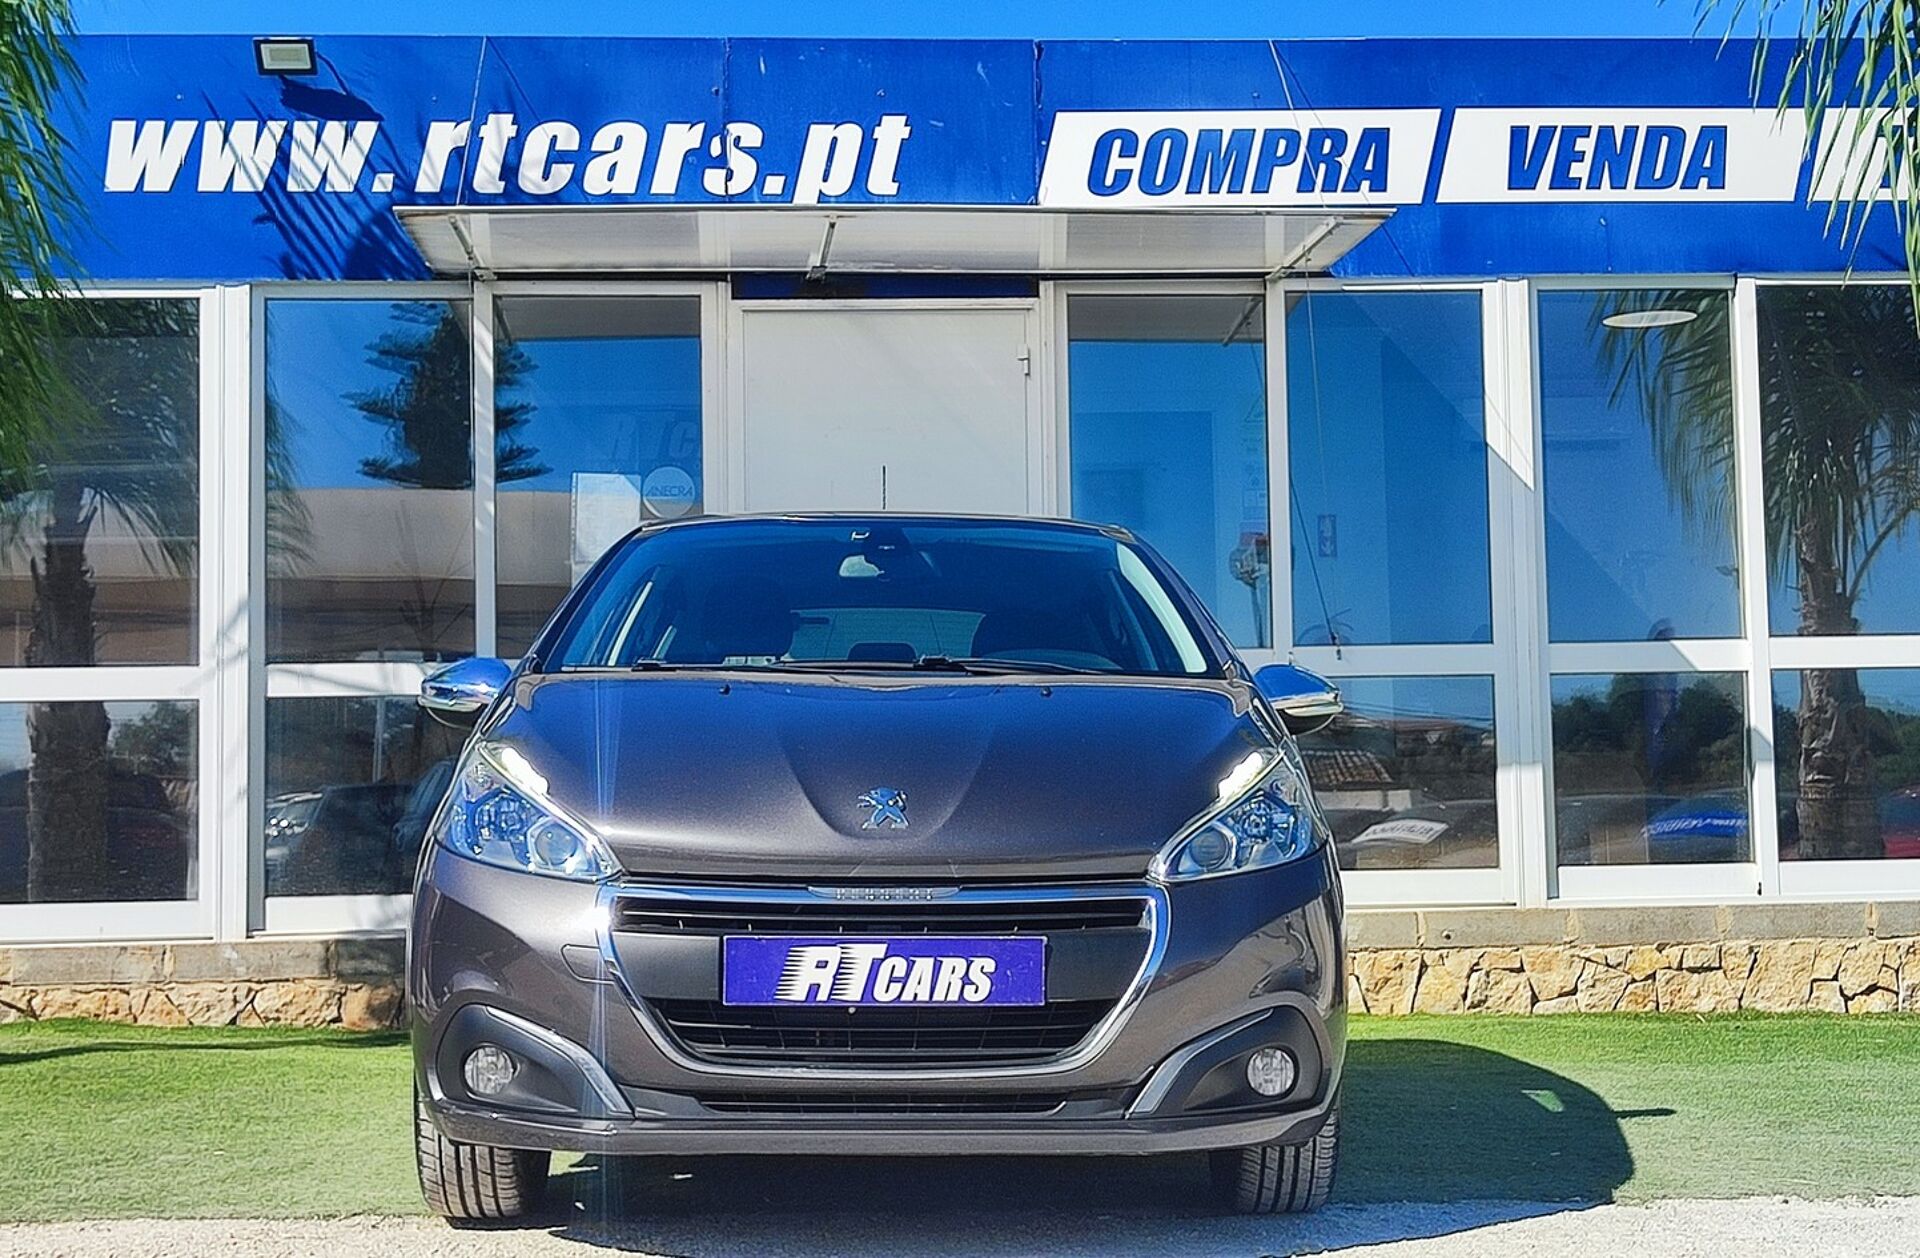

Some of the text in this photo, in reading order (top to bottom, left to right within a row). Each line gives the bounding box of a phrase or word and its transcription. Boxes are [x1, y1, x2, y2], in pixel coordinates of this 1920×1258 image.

[1088, 128, 1389, 196] COMPRA
[1507, 126, 1727, 190] VENDA
[645, 485, 693, 497] ANECRA
